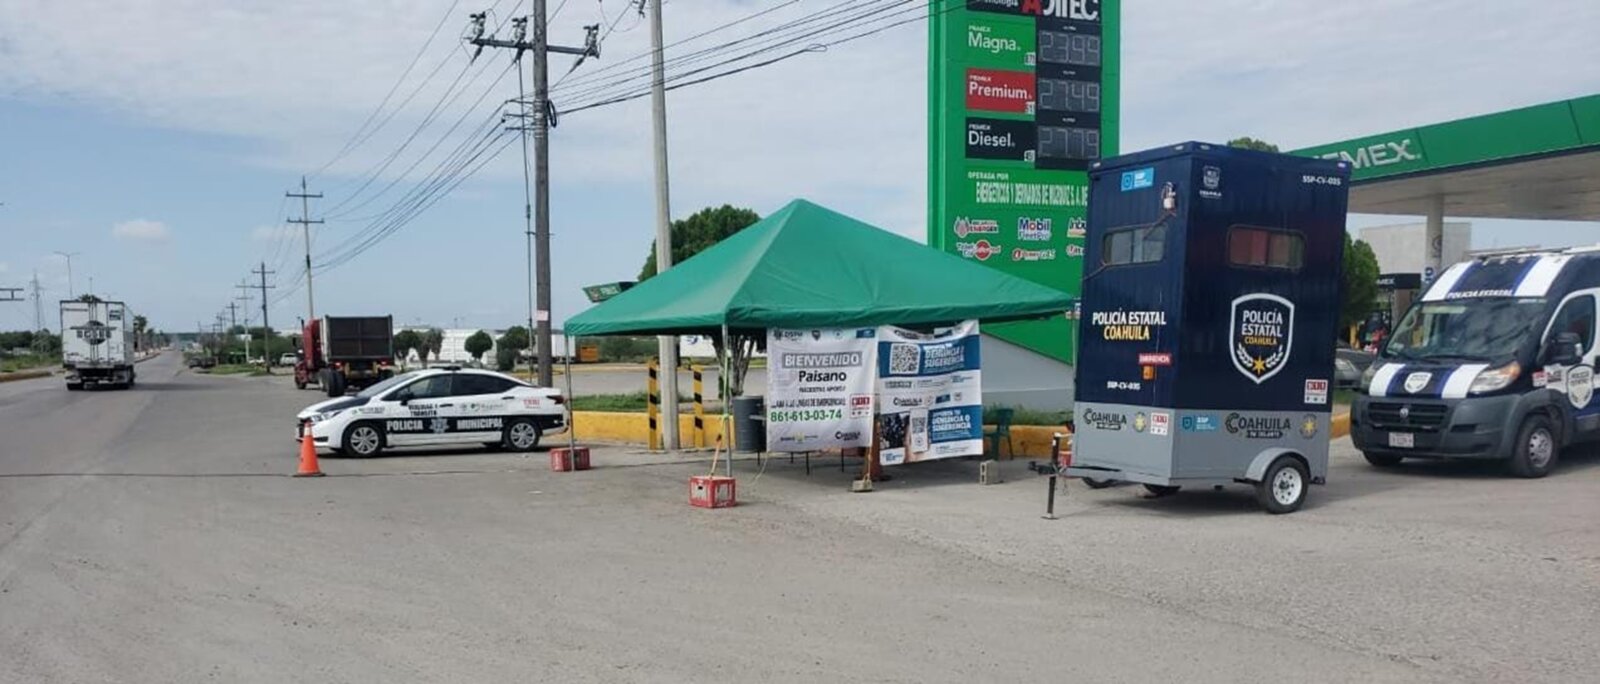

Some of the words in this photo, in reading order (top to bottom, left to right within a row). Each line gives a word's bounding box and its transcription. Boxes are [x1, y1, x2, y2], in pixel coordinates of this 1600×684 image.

[968, 32, 1017, 53] Magna
[969, 82, 1028, 100] Premium
[968, 131, 1012, 147] Diesel
[1018, 218, 1050, 231] Mobil
[1128, 311, 1166, 325] ESTATAL
[1243, 308, 1283, 324] POLICÍA
[1104, 326, 1150, 340] COAHUILA
[1241, 323, 1282, 337] ESTATAL
[1245, 336, 1277, 345] COAHUILA
[785, 354, 859, 367] BIENVENIDO
[799, 371, 847, 383] Paisano
[770, 409, 843, 422] 861-613-03-74
[1083, 408, 1127, 424] COAHUILA
[386, 419, 423, 431] POLICIA
[457, 418, 504, 431] MUNICIPAL
[1225, 412, 1291, 434] COAHUILA
